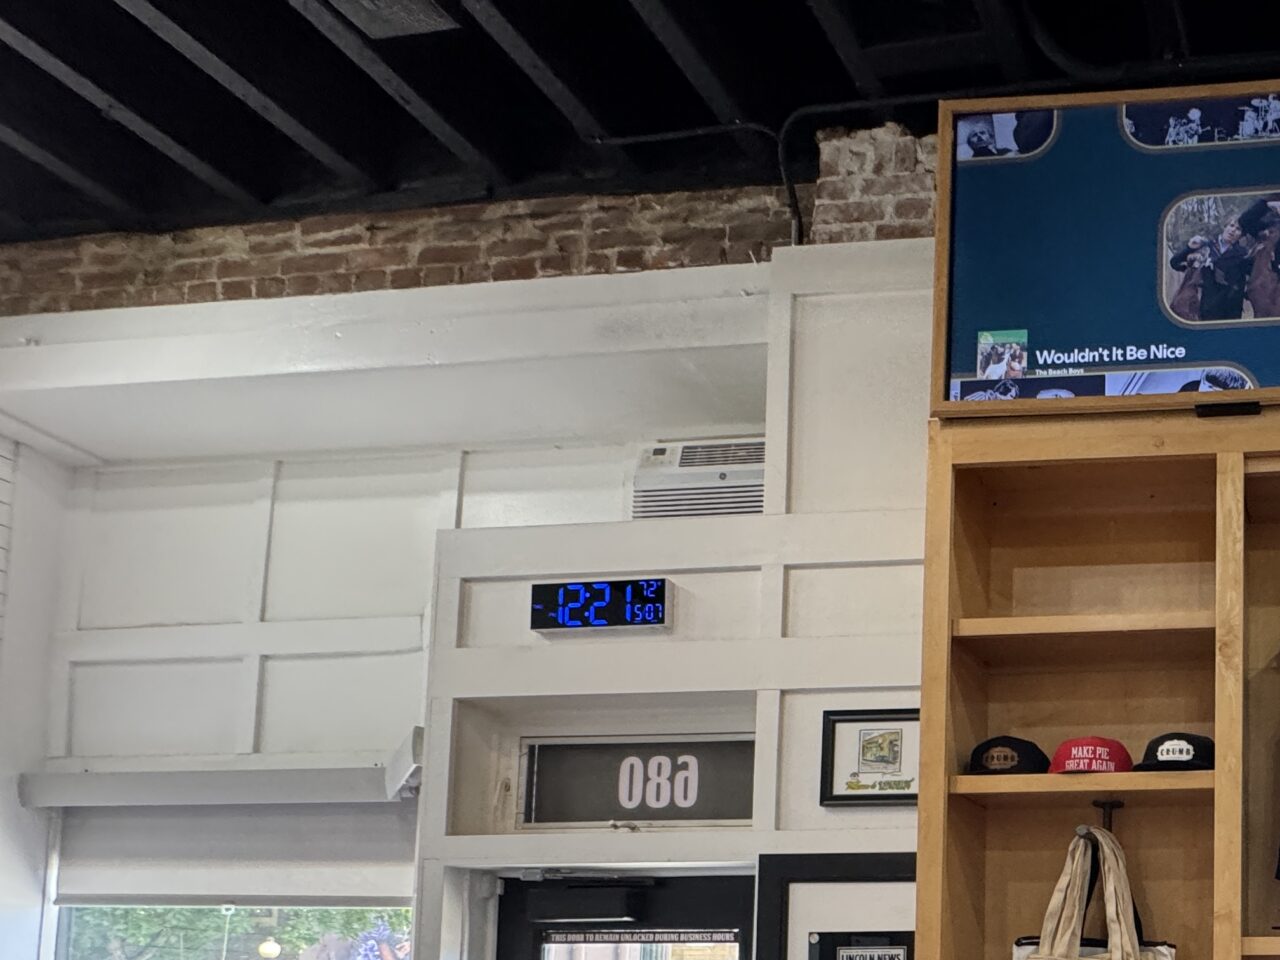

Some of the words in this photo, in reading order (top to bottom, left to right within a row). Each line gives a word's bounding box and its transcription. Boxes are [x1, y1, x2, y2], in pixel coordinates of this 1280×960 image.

[1035, 346, 1110, 365] Wouldn't
[1112, 346, 1124, 362] It
[1126, 345, 1148, 361] Be
[1150, 343, 1186, 360] Nice
[557, 583, 632, 626] 12:21
[1071, 746, 1095, 759] MAKE
[1096, 746, 1110, 760] PIE
[1064, 759, 1090, 771] GREAT
[1091, 759, 1116, 772] AGAIN
[551, 933, 567, 942] THIS
[585, 933, 594, 942] TO
[595, 933, 620, 942] REMAIN
[620, 933, 654, 942] UNLOCKED
[654, 933, 679, 942] DURING
[680, 933, 711, 941] BUSINESS
